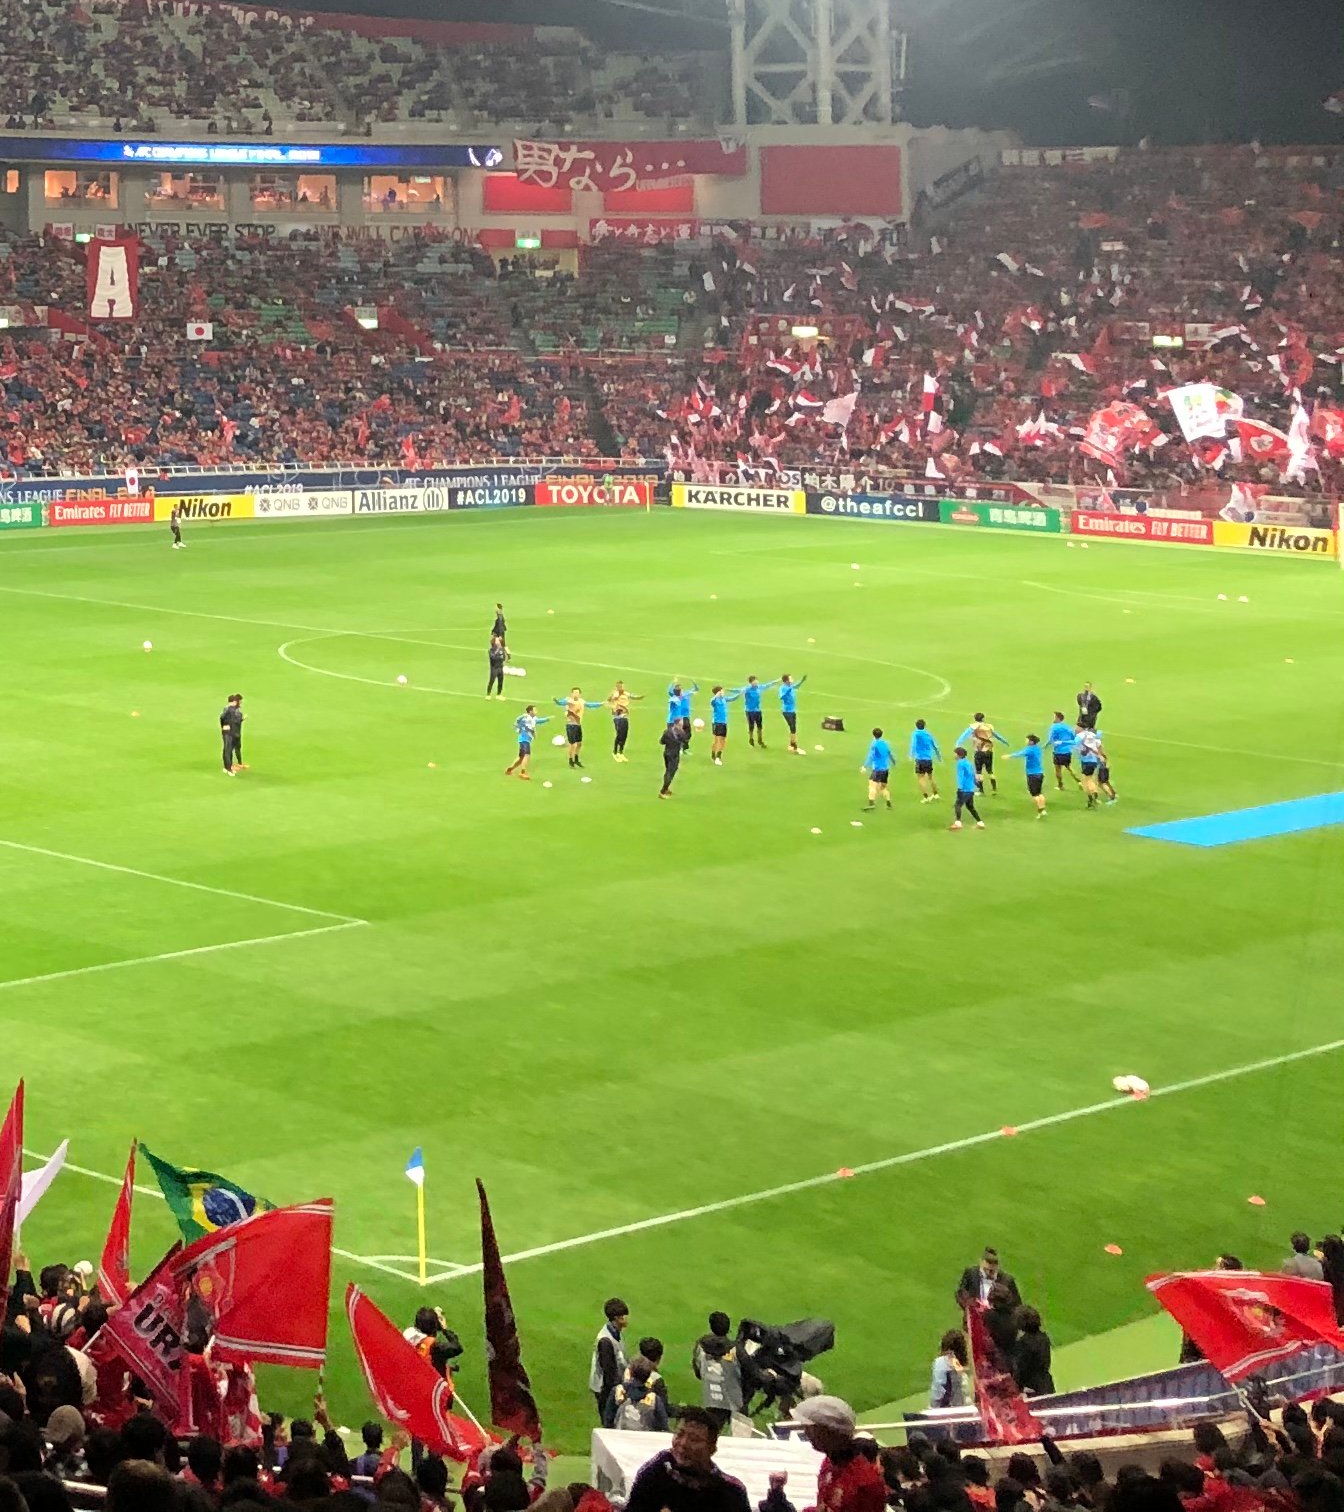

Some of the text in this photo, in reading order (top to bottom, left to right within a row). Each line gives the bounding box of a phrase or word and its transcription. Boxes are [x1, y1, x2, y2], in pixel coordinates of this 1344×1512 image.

[186, 223, 230, 239] EVER
[235, 224, 276, 240] STOP
[424, 474, 490, 488] CHAMPIONS
[18, 487, 64, 504] LEAGUE
[359, 490, 419, 512] Allianz
[457, 488, 526, 505] #ACL2019
[687, 489, 790, 509] KÄRCHER
[55, 504, 106, 521] Emirates
[123, 501, 151, 518] BETTER
[178, 498, 232, 519] Nikon
[821, 496, 925, 518] @theafccl
[1078, 515, 1146, 535] Emirates
[1248, 526, 1329, 553] Nikon
